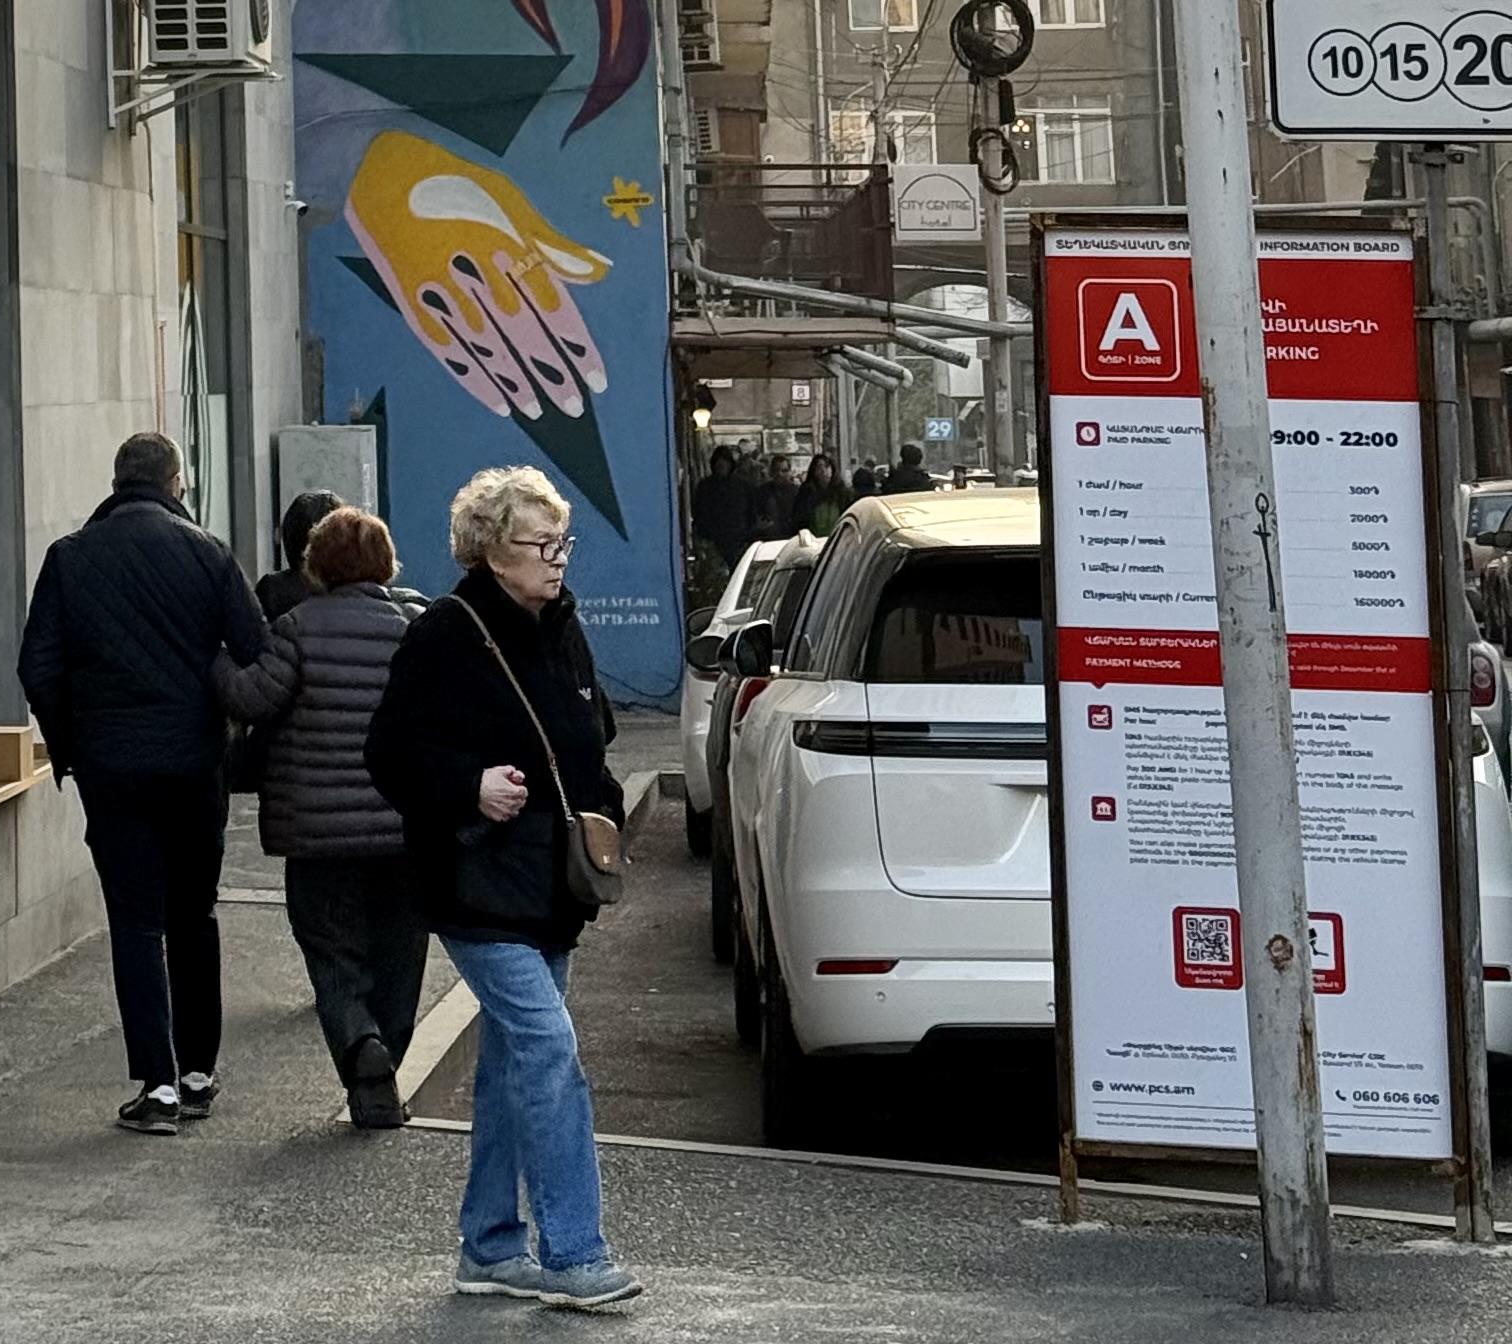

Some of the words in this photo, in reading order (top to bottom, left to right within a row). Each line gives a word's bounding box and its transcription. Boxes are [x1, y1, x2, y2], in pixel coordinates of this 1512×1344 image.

[1320, 45, 1364, 80] 10
[1379, 43, 1429, 82] 15
[1259, 240, 1350, 253] INFORMATION
[1353, 241, 1400, 253] BOARD
[1098, 292, 1161, 351] A
[1265, 345, 1321, 361] RKING
[928, 420, 952, 437] 29
[1338, 430, 1399, 448] 22:00
[1108, 1082, 1196, 1096] www.pcs.am
[1352, 1090, 1380, 1102] 060
[1383, 1092, 1410, 1104] 606
[1413, 1093, 1440, 1105] 606
